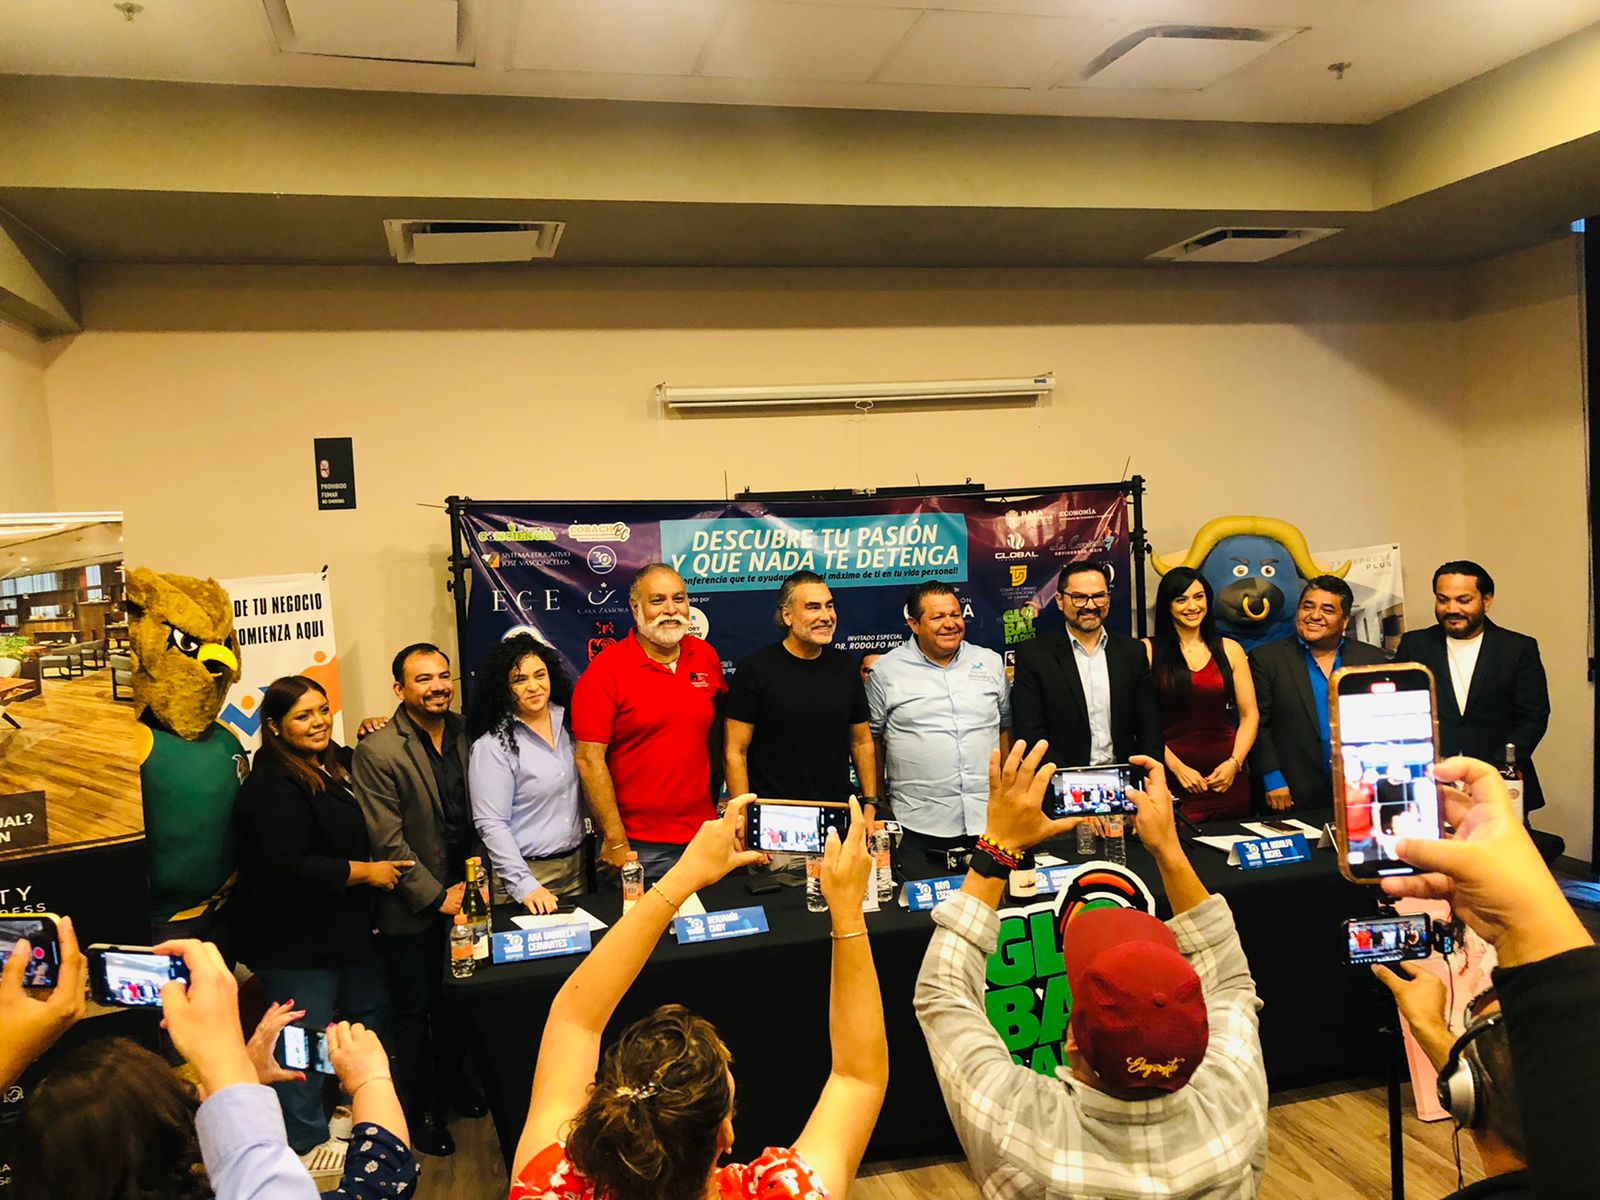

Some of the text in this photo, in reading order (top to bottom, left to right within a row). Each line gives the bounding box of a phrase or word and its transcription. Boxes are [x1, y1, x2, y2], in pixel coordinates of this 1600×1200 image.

[320, 482, 347, 490] PROHIBIDO
[1059, 508, 1097, 516] ECONOMÍA
[692, 518, 938, 551] DESCUBRE TU PASIÓN
[671, 545, 959, 577] Y QUE NADA TE DETENGA
[994, 551, 1039, 560] GLOBAL
[684, 575, 727, 586] onferencia
[729, 575, 743, 585] que
[747, 574, 756, 583] te
[828, 571, 860, 580] máximo
[862, 570, 872, 578] de
[882, 570, 891, 578] en
[893, 569, 902, 577] tu
[903, 568, 919, 577] vida
[921, 566, 959, 578] personal!
[234, 592, 322, 617] DE TU NEGOCIO
[238, 620, 324, 646] OMIENZA AQUI
[849, 641, 887, 650] RODOLFO
